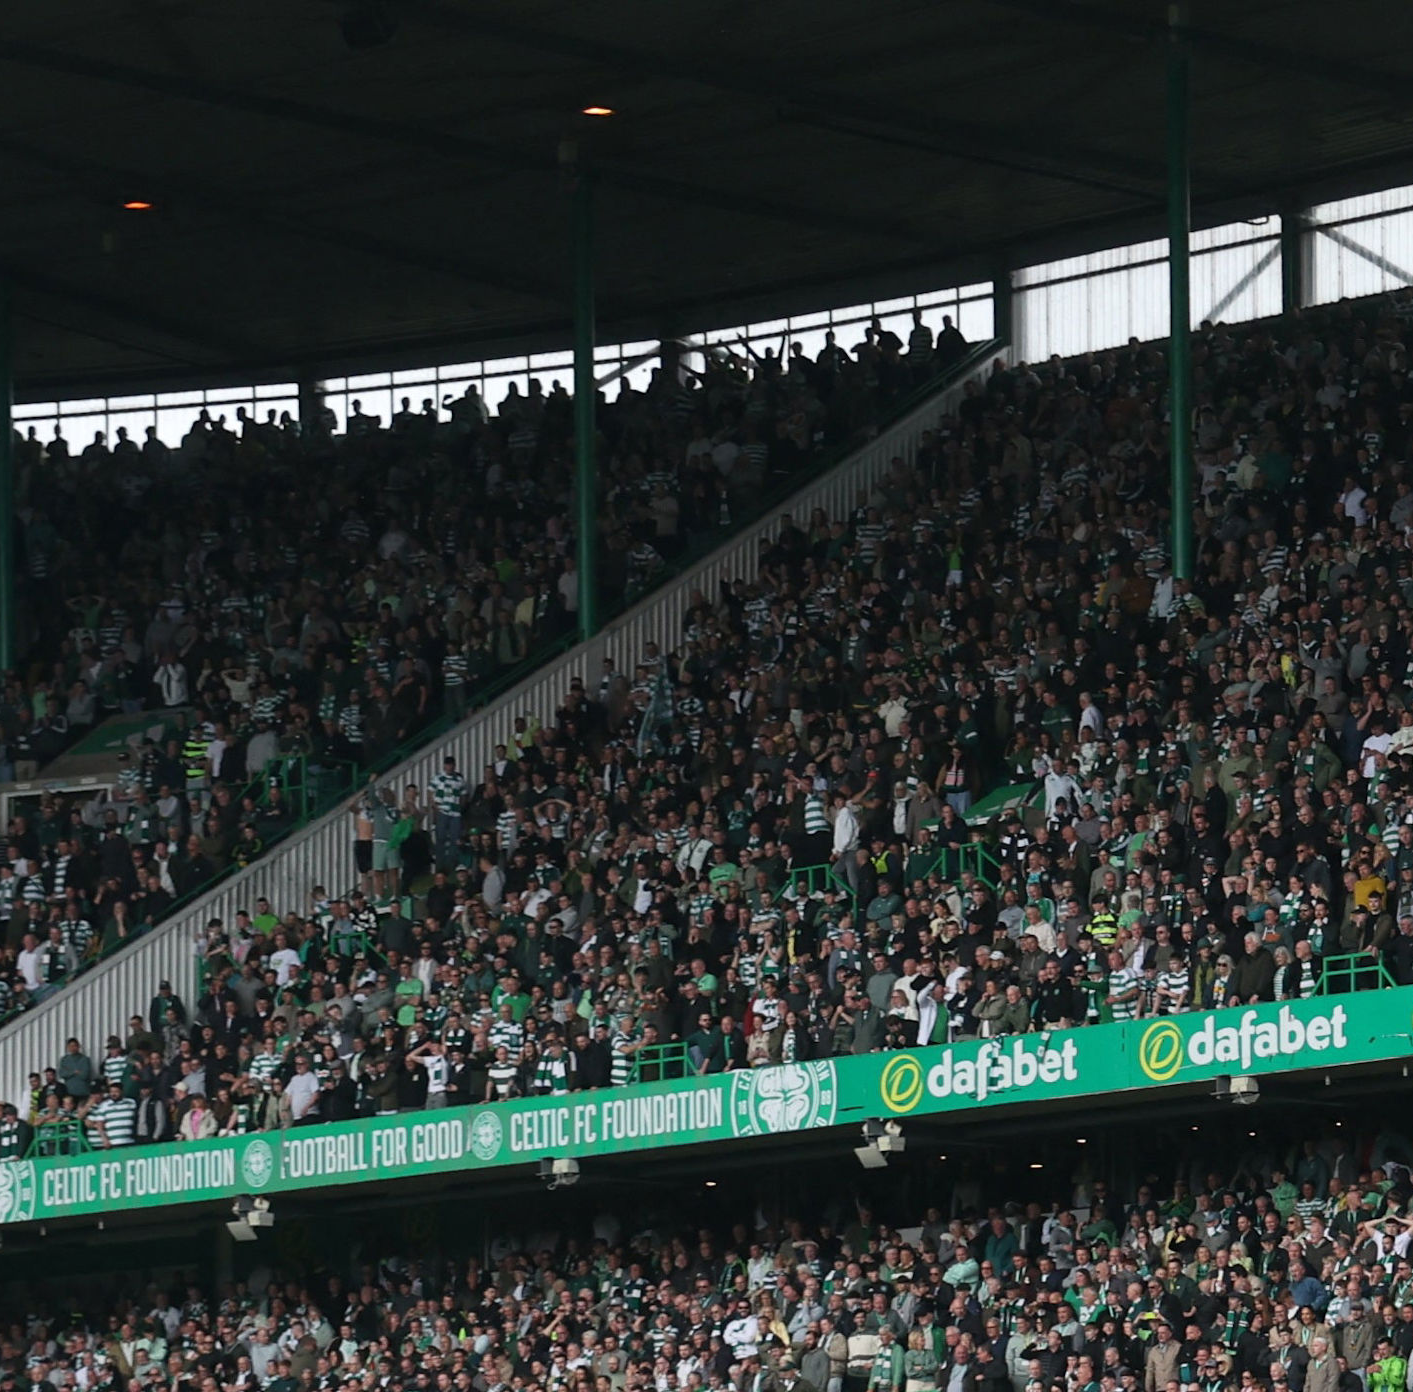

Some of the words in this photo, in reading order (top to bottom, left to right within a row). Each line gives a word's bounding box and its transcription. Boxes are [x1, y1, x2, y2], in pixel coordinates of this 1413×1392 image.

[1188, 1004, 1348, 1071] dafabet
[927, 1038, 1078, 1102] dafabet
[372, 1127, 408, 1169] FOR
[412, 1119, 463, 1164] GOOD
[510, 1107, 568, 1152] CELTIC
[574, 1103, 597, 1145] FC
[602, 1086, 722, 1139] FOUNDATION
[42, 1163, 97, 1207] CELTIC
[100, 1159, 122, 1201] FC
[126, 1148, 235, 1198] FOUNDATION
